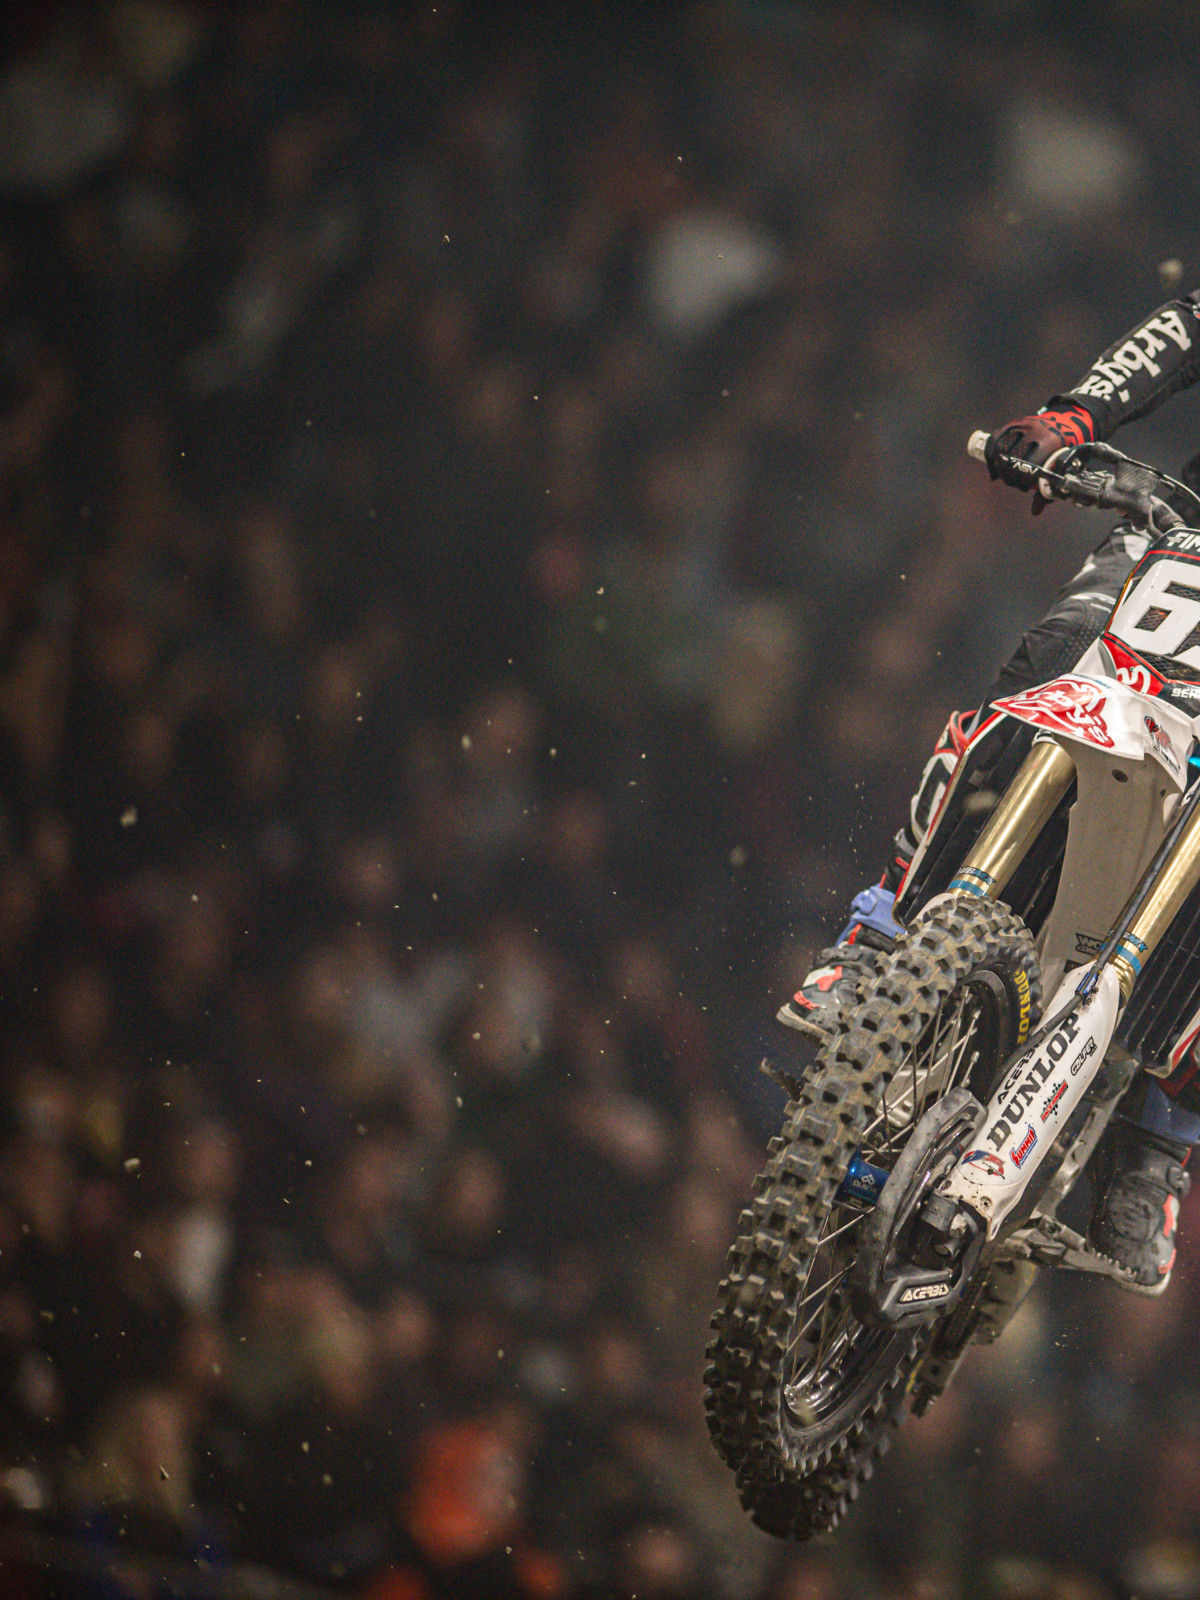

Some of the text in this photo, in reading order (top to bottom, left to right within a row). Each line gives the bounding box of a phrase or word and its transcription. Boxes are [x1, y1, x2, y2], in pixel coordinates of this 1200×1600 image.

[1069, 310, 1192, 403] Arby's
[1012, 460, 1040, 476] ASV
[986, 1012, 1080, 1152] DUNLOP
[997, 1038, 1046, 1105] ACERB
[901, 1283, 950, 1302] ACERBIS
